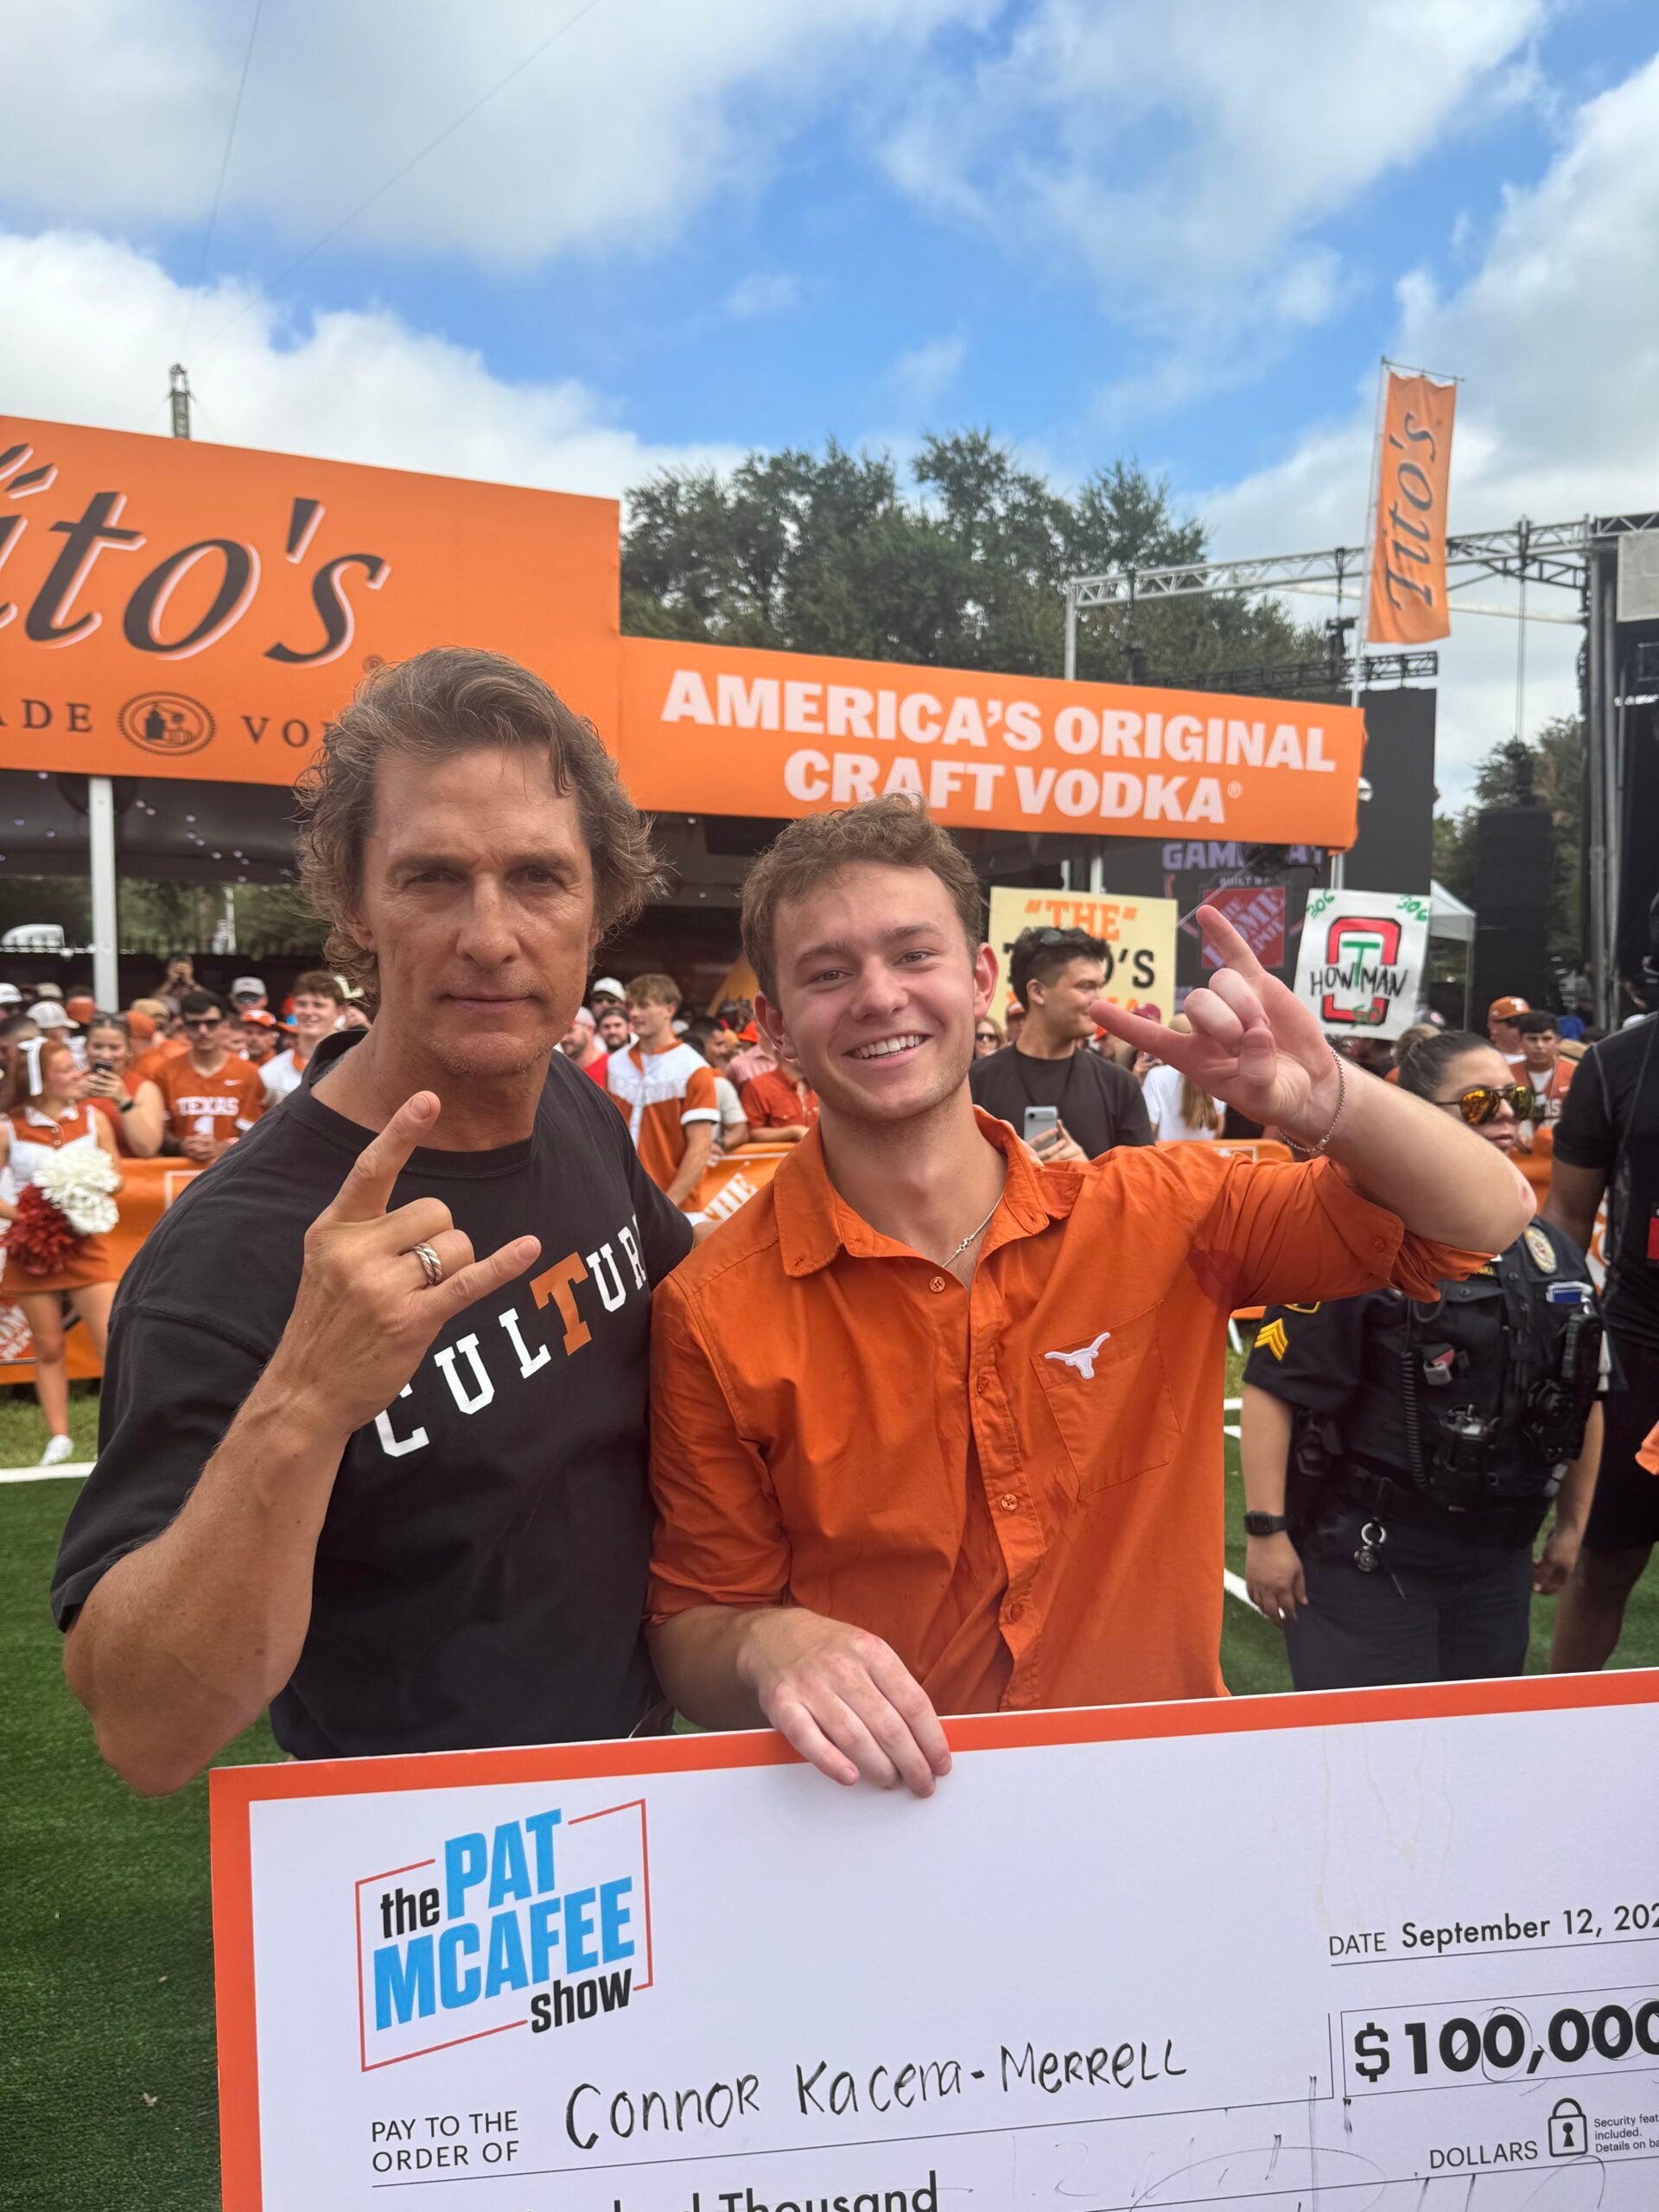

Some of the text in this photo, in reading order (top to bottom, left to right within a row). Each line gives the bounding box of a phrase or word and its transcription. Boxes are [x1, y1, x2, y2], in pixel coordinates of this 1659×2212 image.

[1384, 410, 1436, 611] Tito's
[661, 670, 1335, 773] AMERICA'S ORIGINAL
[784, 748, 1005, 813] CRAFT
[176, 1096, 239, 1116] TEXAS
[380, 1808, 562, 1939] the PAT
[1330, 1932, 1387, 1956] DATE
[1402, 1913, 1551, 1954] September
[1563, 1908, 1602, 1937] 12,
[373, 1876, 635, 2031] MCAFEE
[531, 1967, 632, 2033] show
[372, 2110, 518, 2143] PAY TO THE
[1594, 2114, 1637, 2128] Security
[1595, 2127, 1642, 2140] included.
[372, 2140, 519, 2172] ORDER OF
[1430, 2140, 1538, 2170] DOLLARS
[1595, 2141, 1630, 2153] Details
[1633, 2141, 1646, 2150] on
